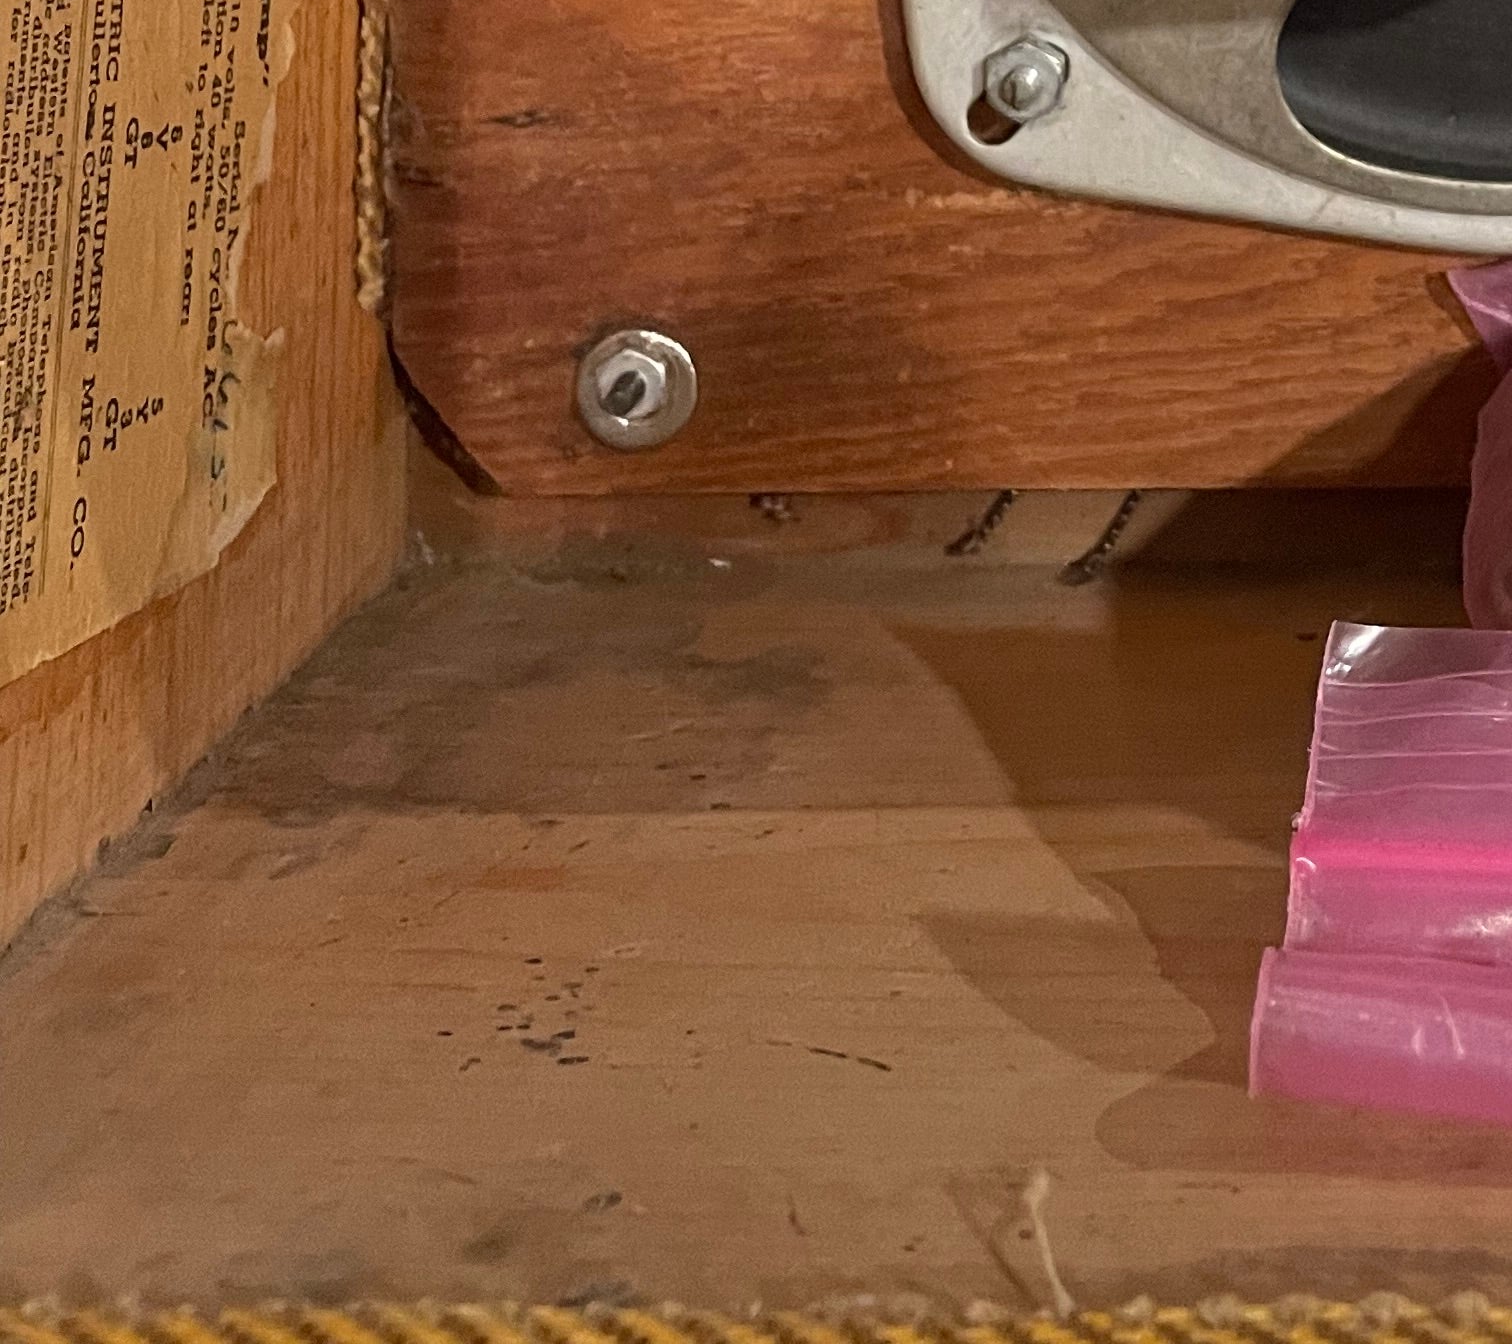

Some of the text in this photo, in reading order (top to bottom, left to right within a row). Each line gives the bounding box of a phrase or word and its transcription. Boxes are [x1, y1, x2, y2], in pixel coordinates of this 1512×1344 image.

[46, 30, 64, 137] Western
[198, 63, 208, 92] to
[211, 74, 222, 108] 40
[56, 133, 64, 156] of
[190, 109, 205, 184] right
[229, 121, 246, 214] Serial
[37, 155, 54, 252] Electric
[85, 102, 116, 353] INSTRUMENT
[187, 200, 197, 232] at
[214, 145, 231, 233] 50/60
[70, 151, 96, 331] California
[206, 248, 223, 351] cycles
[77, 374, 96, 477] MFG.
[26, 470, 38, 522] and
[70, 497, 87, 571] CO.
